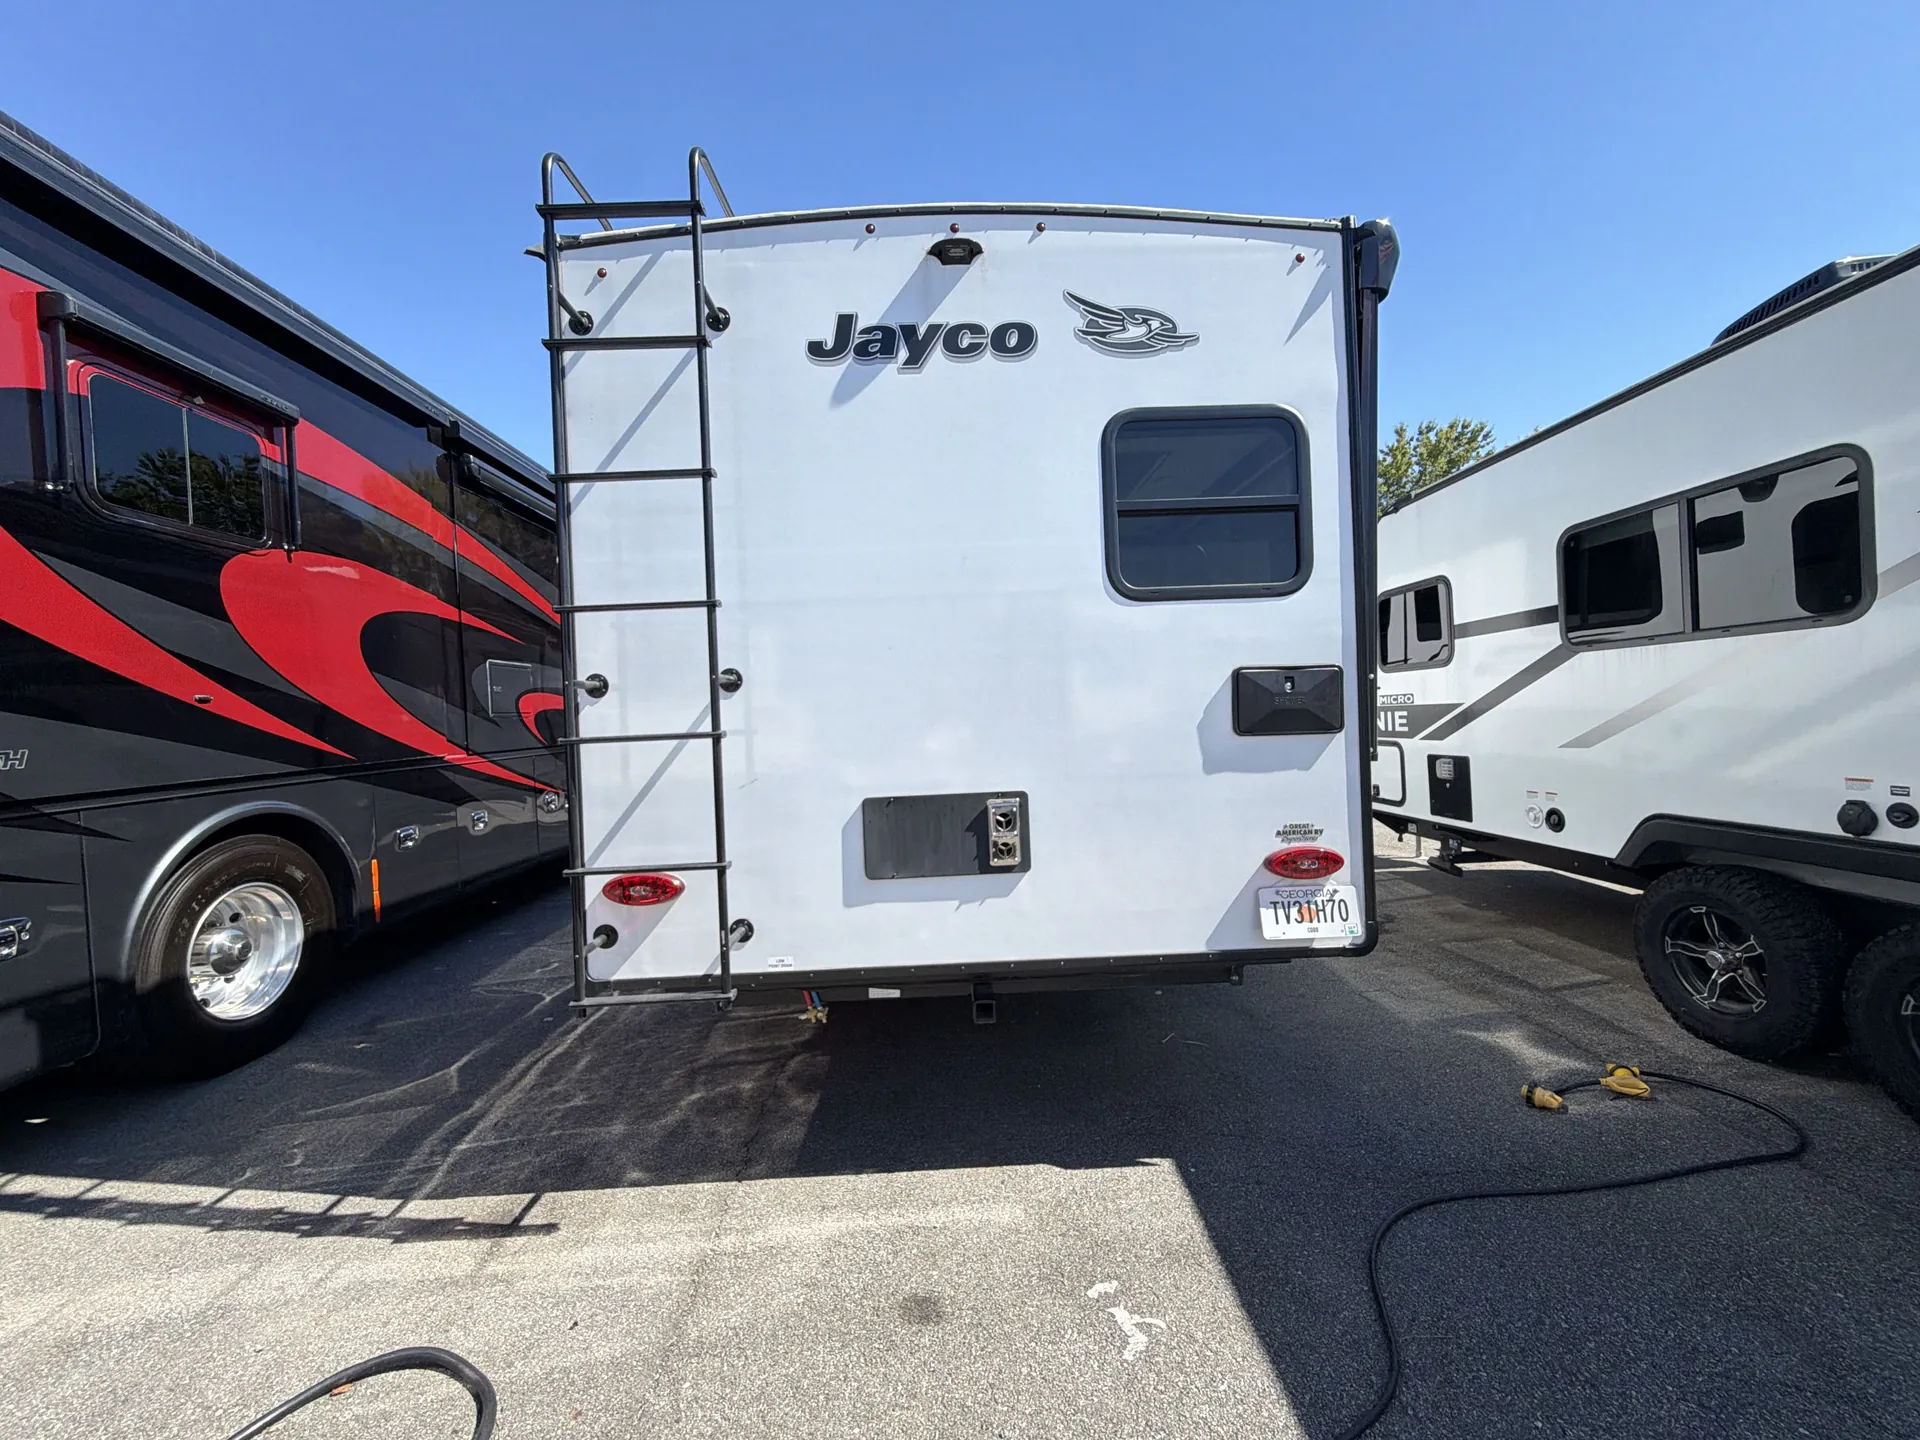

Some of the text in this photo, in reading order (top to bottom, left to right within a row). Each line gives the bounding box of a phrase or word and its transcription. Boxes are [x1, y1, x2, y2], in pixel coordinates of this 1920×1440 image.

[806, 312, 1038, 371] Jayco
[1379, 694, 1413, 705] MICRO
[0, 749, 28, 770] H
[1275, 828, 1324, 837] AMERICAN RV
[1280, 888, 1331, 899] GEORGIA
[1269, 898, 1349, 925] TV31H70
